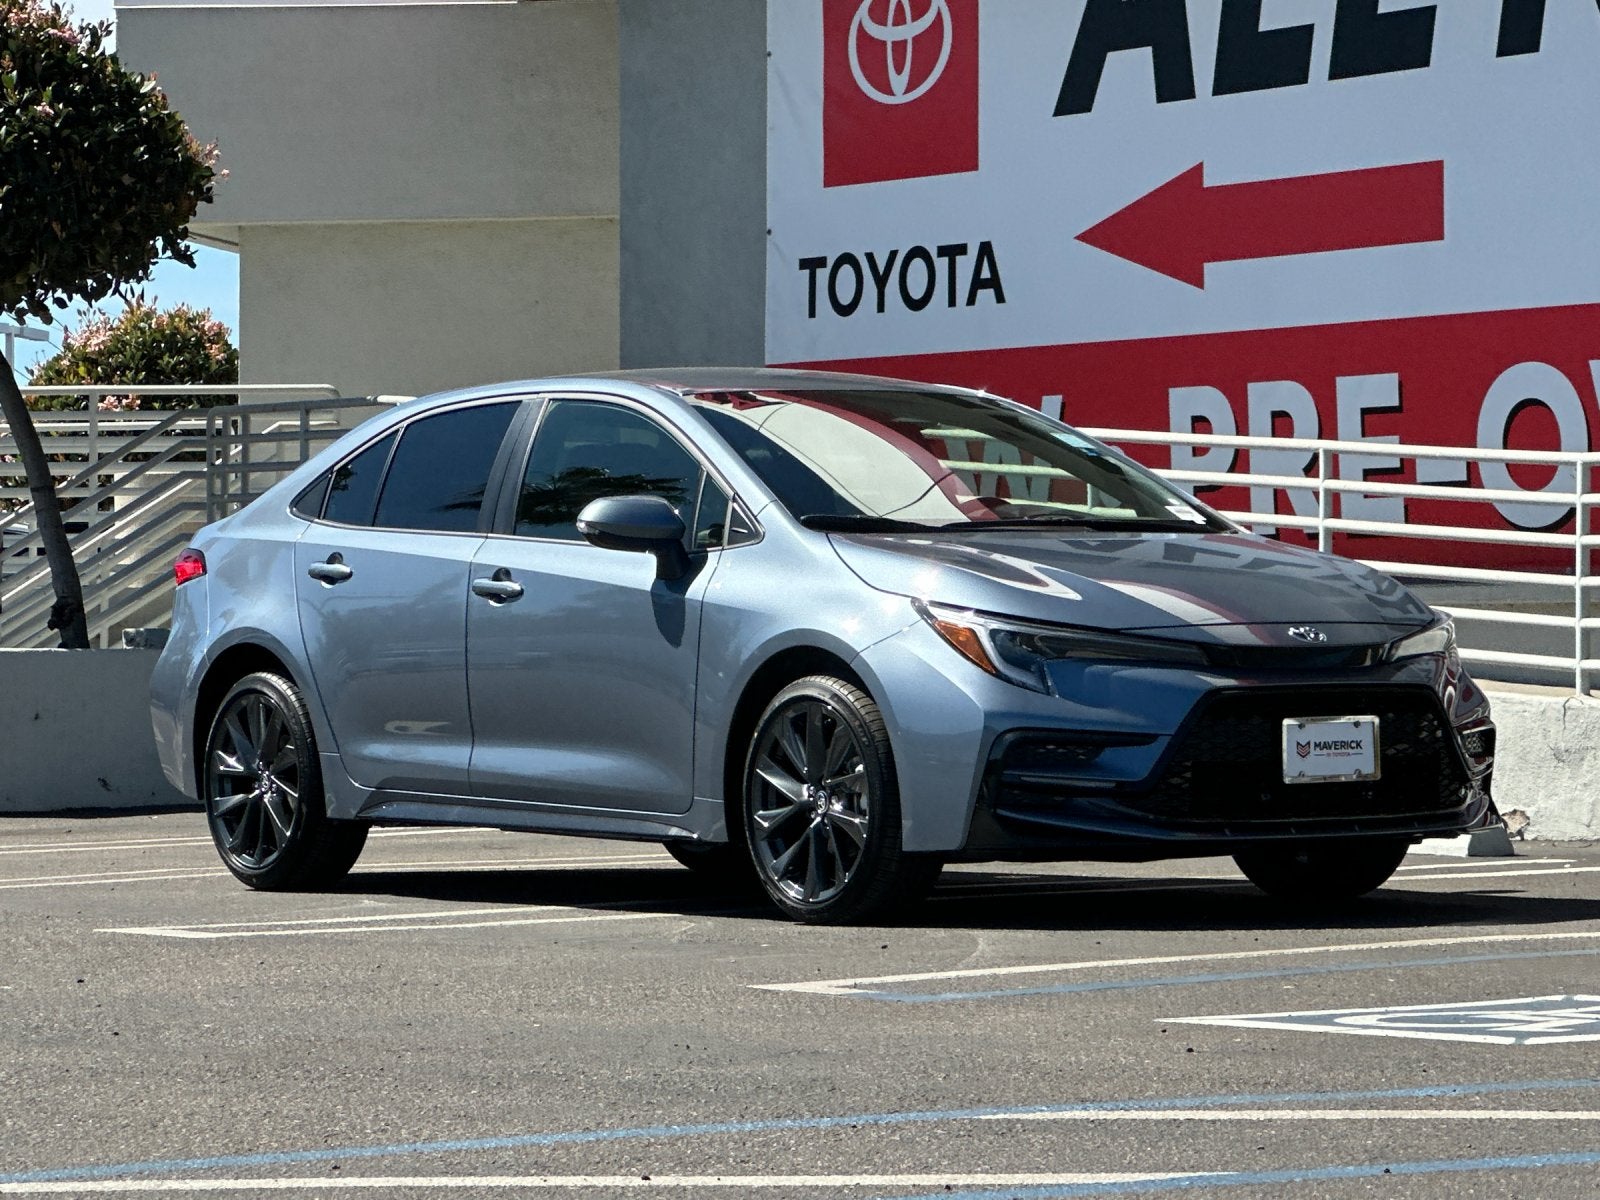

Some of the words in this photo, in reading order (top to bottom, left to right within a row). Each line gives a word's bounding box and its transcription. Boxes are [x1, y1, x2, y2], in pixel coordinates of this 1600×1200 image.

[799, 240, 1006, 318] TOYOTA
[1168, 359, 1600, 537] PRE-O
[1313, 740, 1363, 751] MAVERICK
